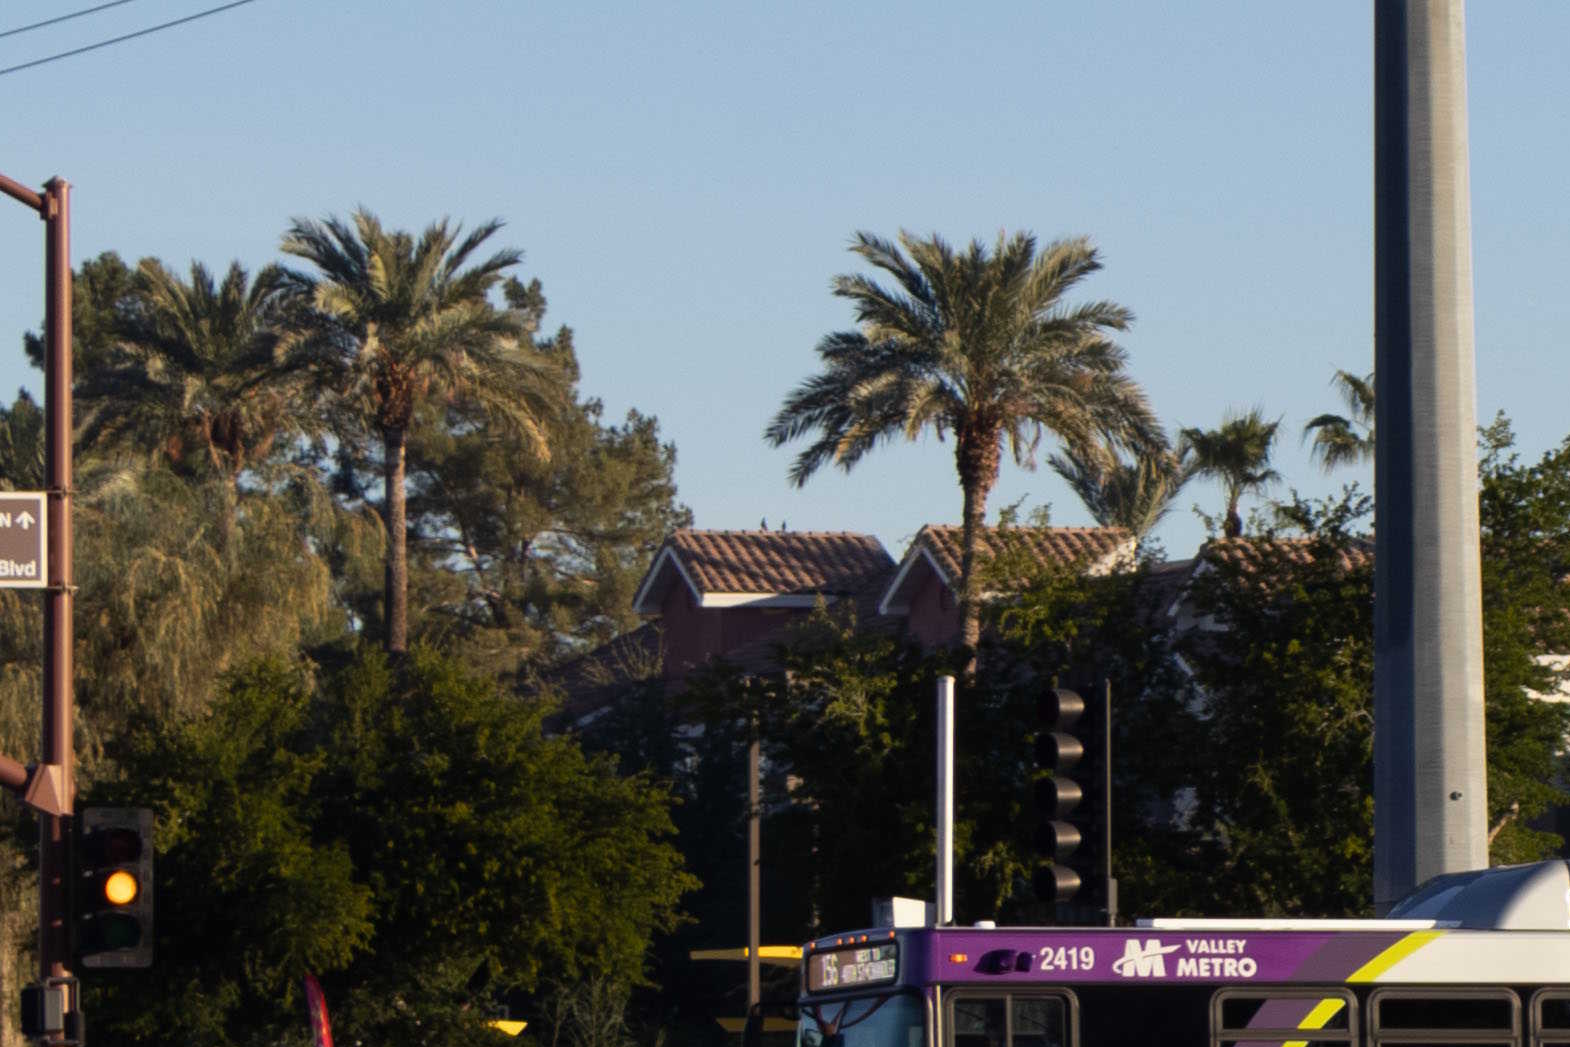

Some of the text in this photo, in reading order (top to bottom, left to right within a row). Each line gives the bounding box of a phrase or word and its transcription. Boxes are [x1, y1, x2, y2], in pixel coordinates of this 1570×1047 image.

[0, 559, 37, 577] Blvd
[1186, 939, 1247, 954] VALLEY
[1040, 947, 1095, 970] 2419
[1176, 957, 1258, 977] METRO
